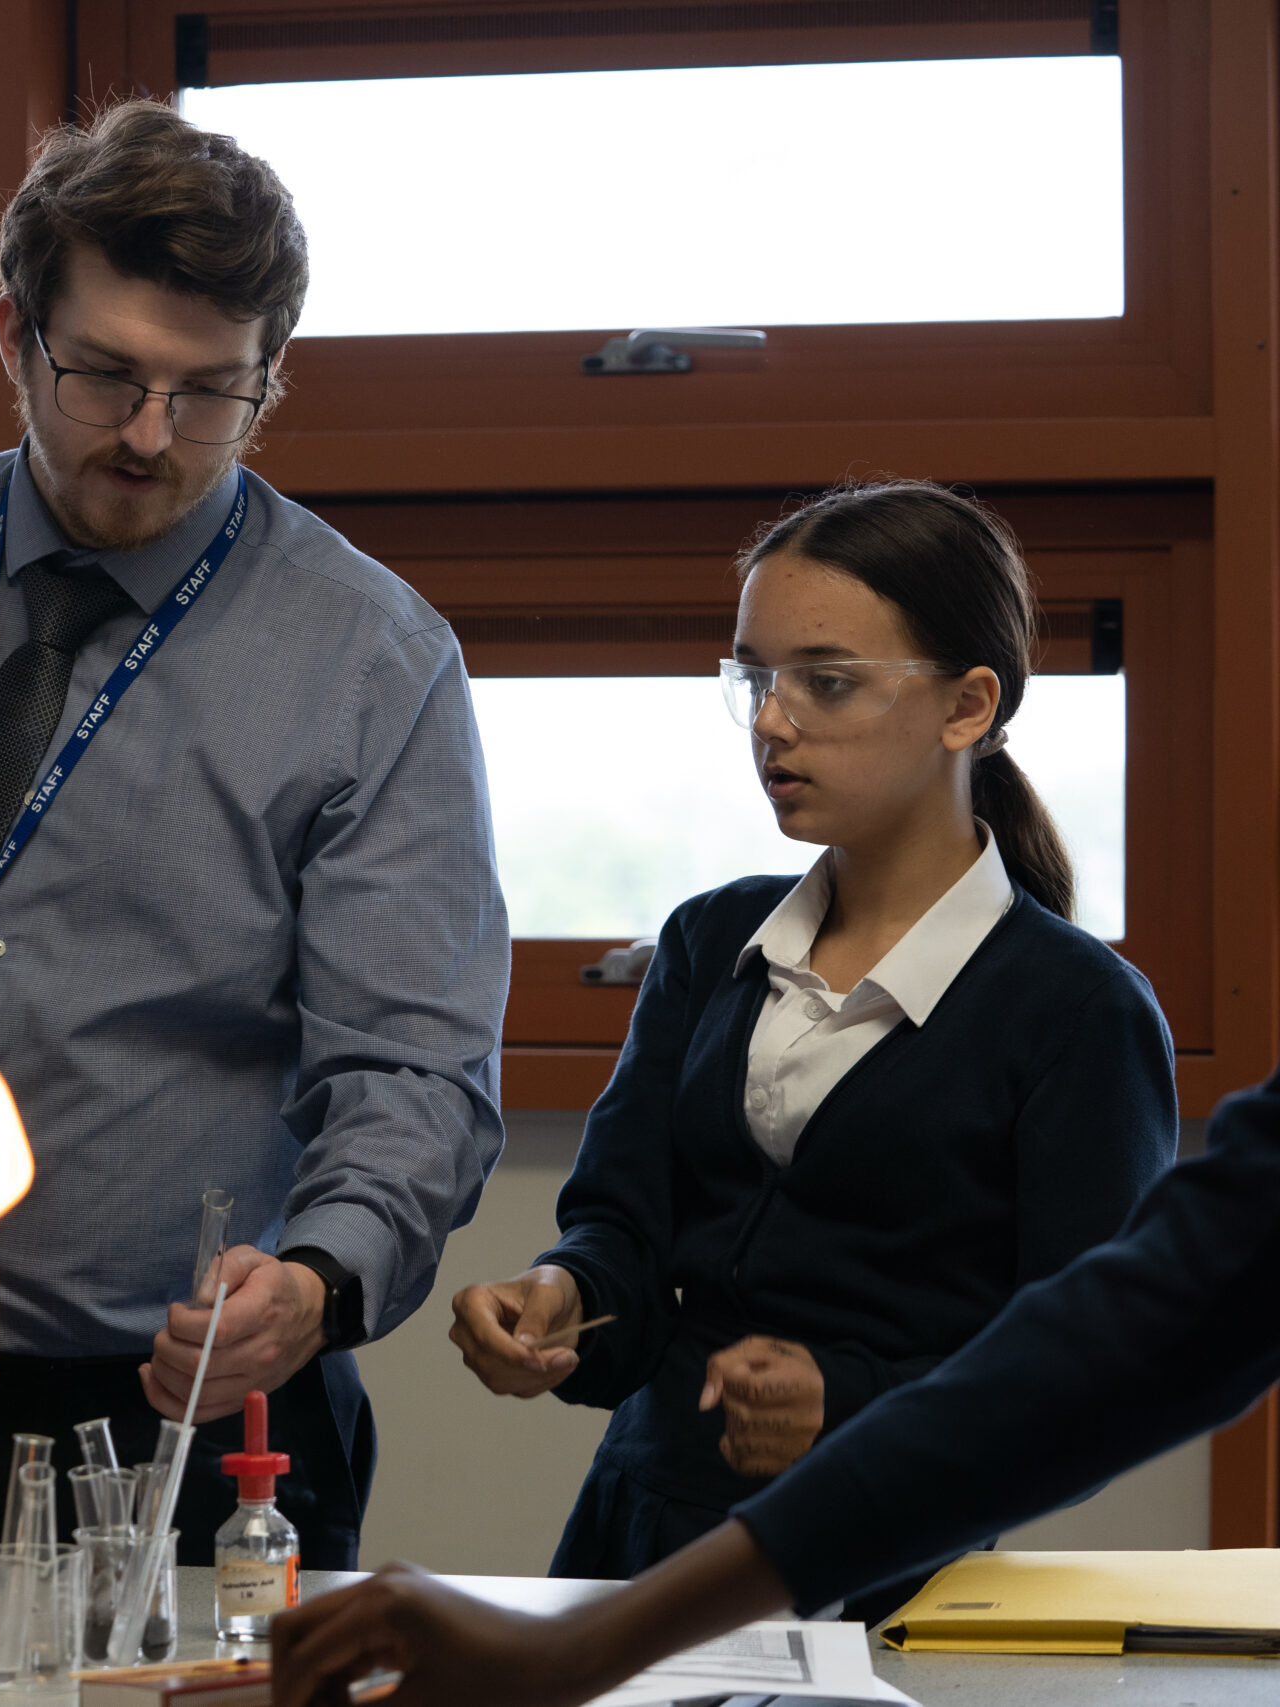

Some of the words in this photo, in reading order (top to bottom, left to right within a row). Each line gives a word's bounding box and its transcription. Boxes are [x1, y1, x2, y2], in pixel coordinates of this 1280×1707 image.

[225, 493, 247, 539] STAFF
[175, 559, 212, 605] STAFF
[124, 623, 161, 670] STAFF
[76, 693, 112, 740] STAFF
[31, 764, 64, 813] STAFF
